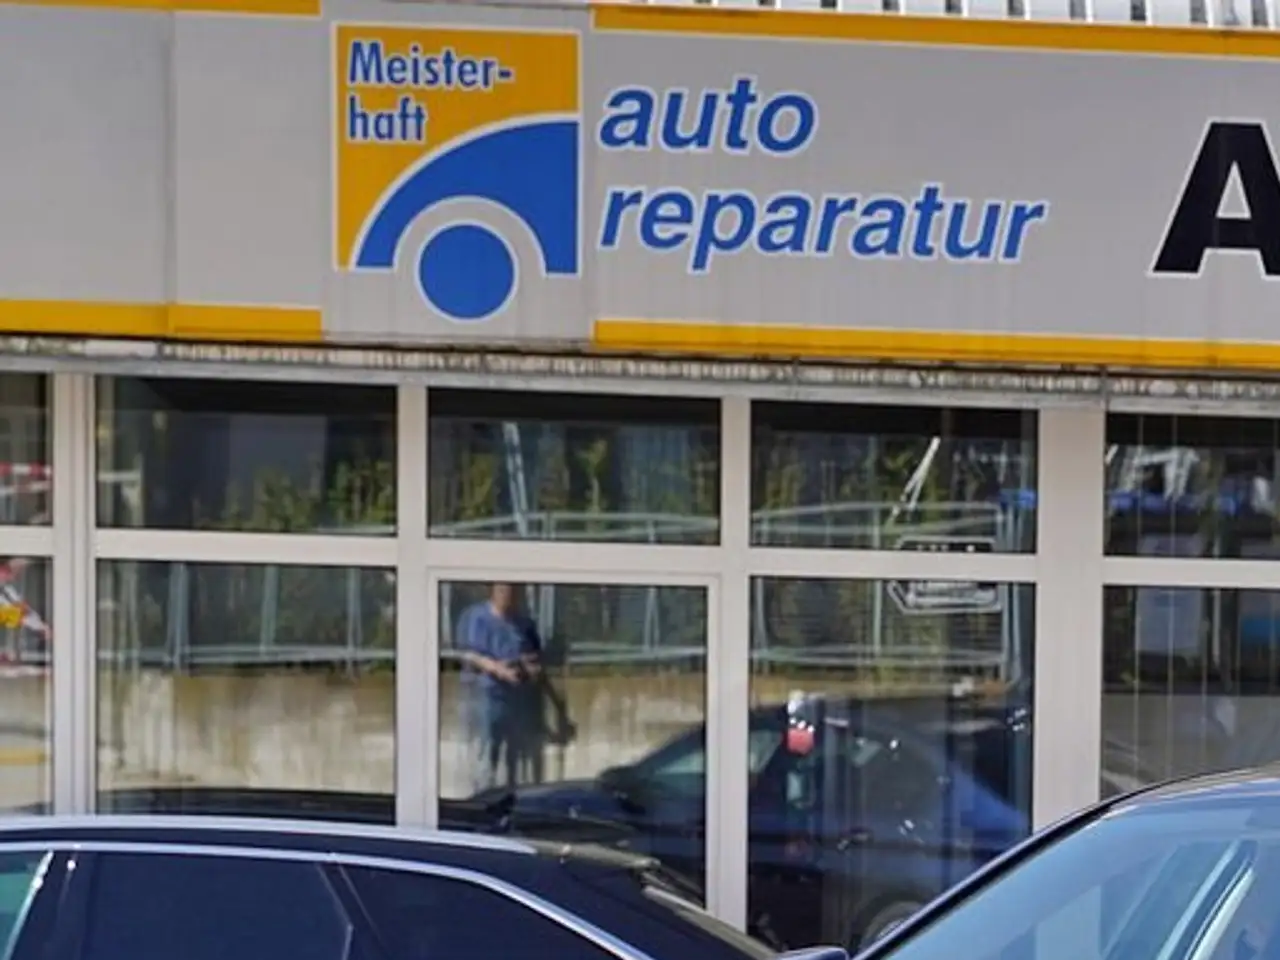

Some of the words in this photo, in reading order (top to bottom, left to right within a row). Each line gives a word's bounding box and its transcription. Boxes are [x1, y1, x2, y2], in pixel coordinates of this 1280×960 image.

[348, 42, 512, 88] Meister-
[348, 98, 426, 141] haft
[600, 78, 816, 152] auto
[600, 186, 1044, 271] reparatur
